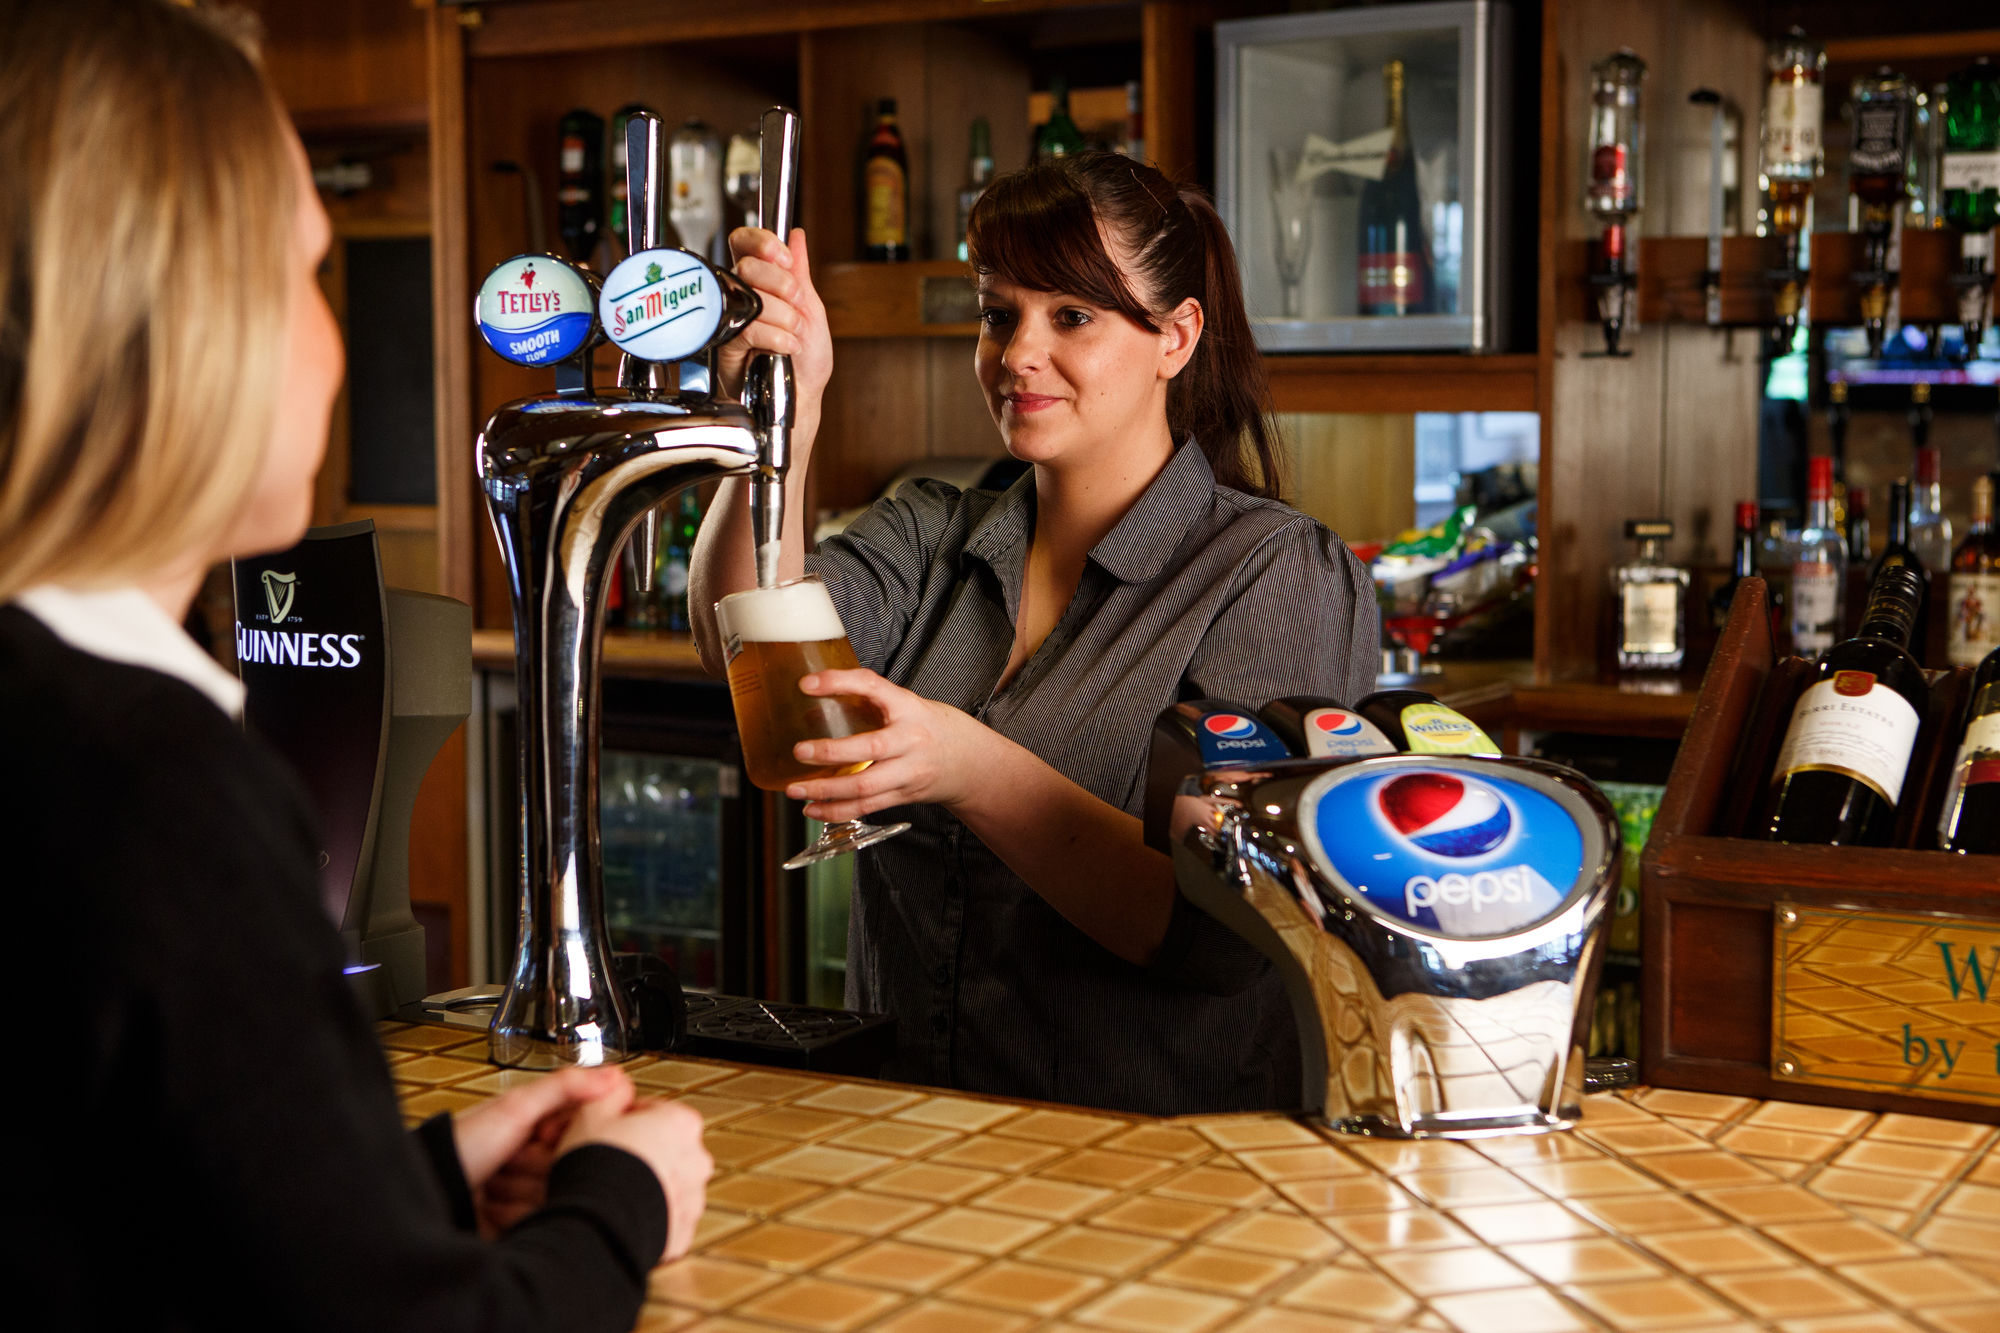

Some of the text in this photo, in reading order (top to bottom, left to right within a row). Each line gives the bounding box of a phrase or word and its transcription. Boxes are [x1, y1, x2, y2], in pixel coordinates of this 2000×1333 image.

[497, 290, 560, 314] TETLEY'S
[613, 276, 702, 336] San Miguel
[509, 329, 560, 355] SMOOTH
[525, 349, 548, 362] FLOW
[236, 620, 361, 668] GUINNESS
[1216, 738, 1267, 751] pepsi
[1326, 737, 1376, 749] pepsi
[1405, 864, 1533, 917] pepsi
[1902, 1023, 1967, 1079] by
